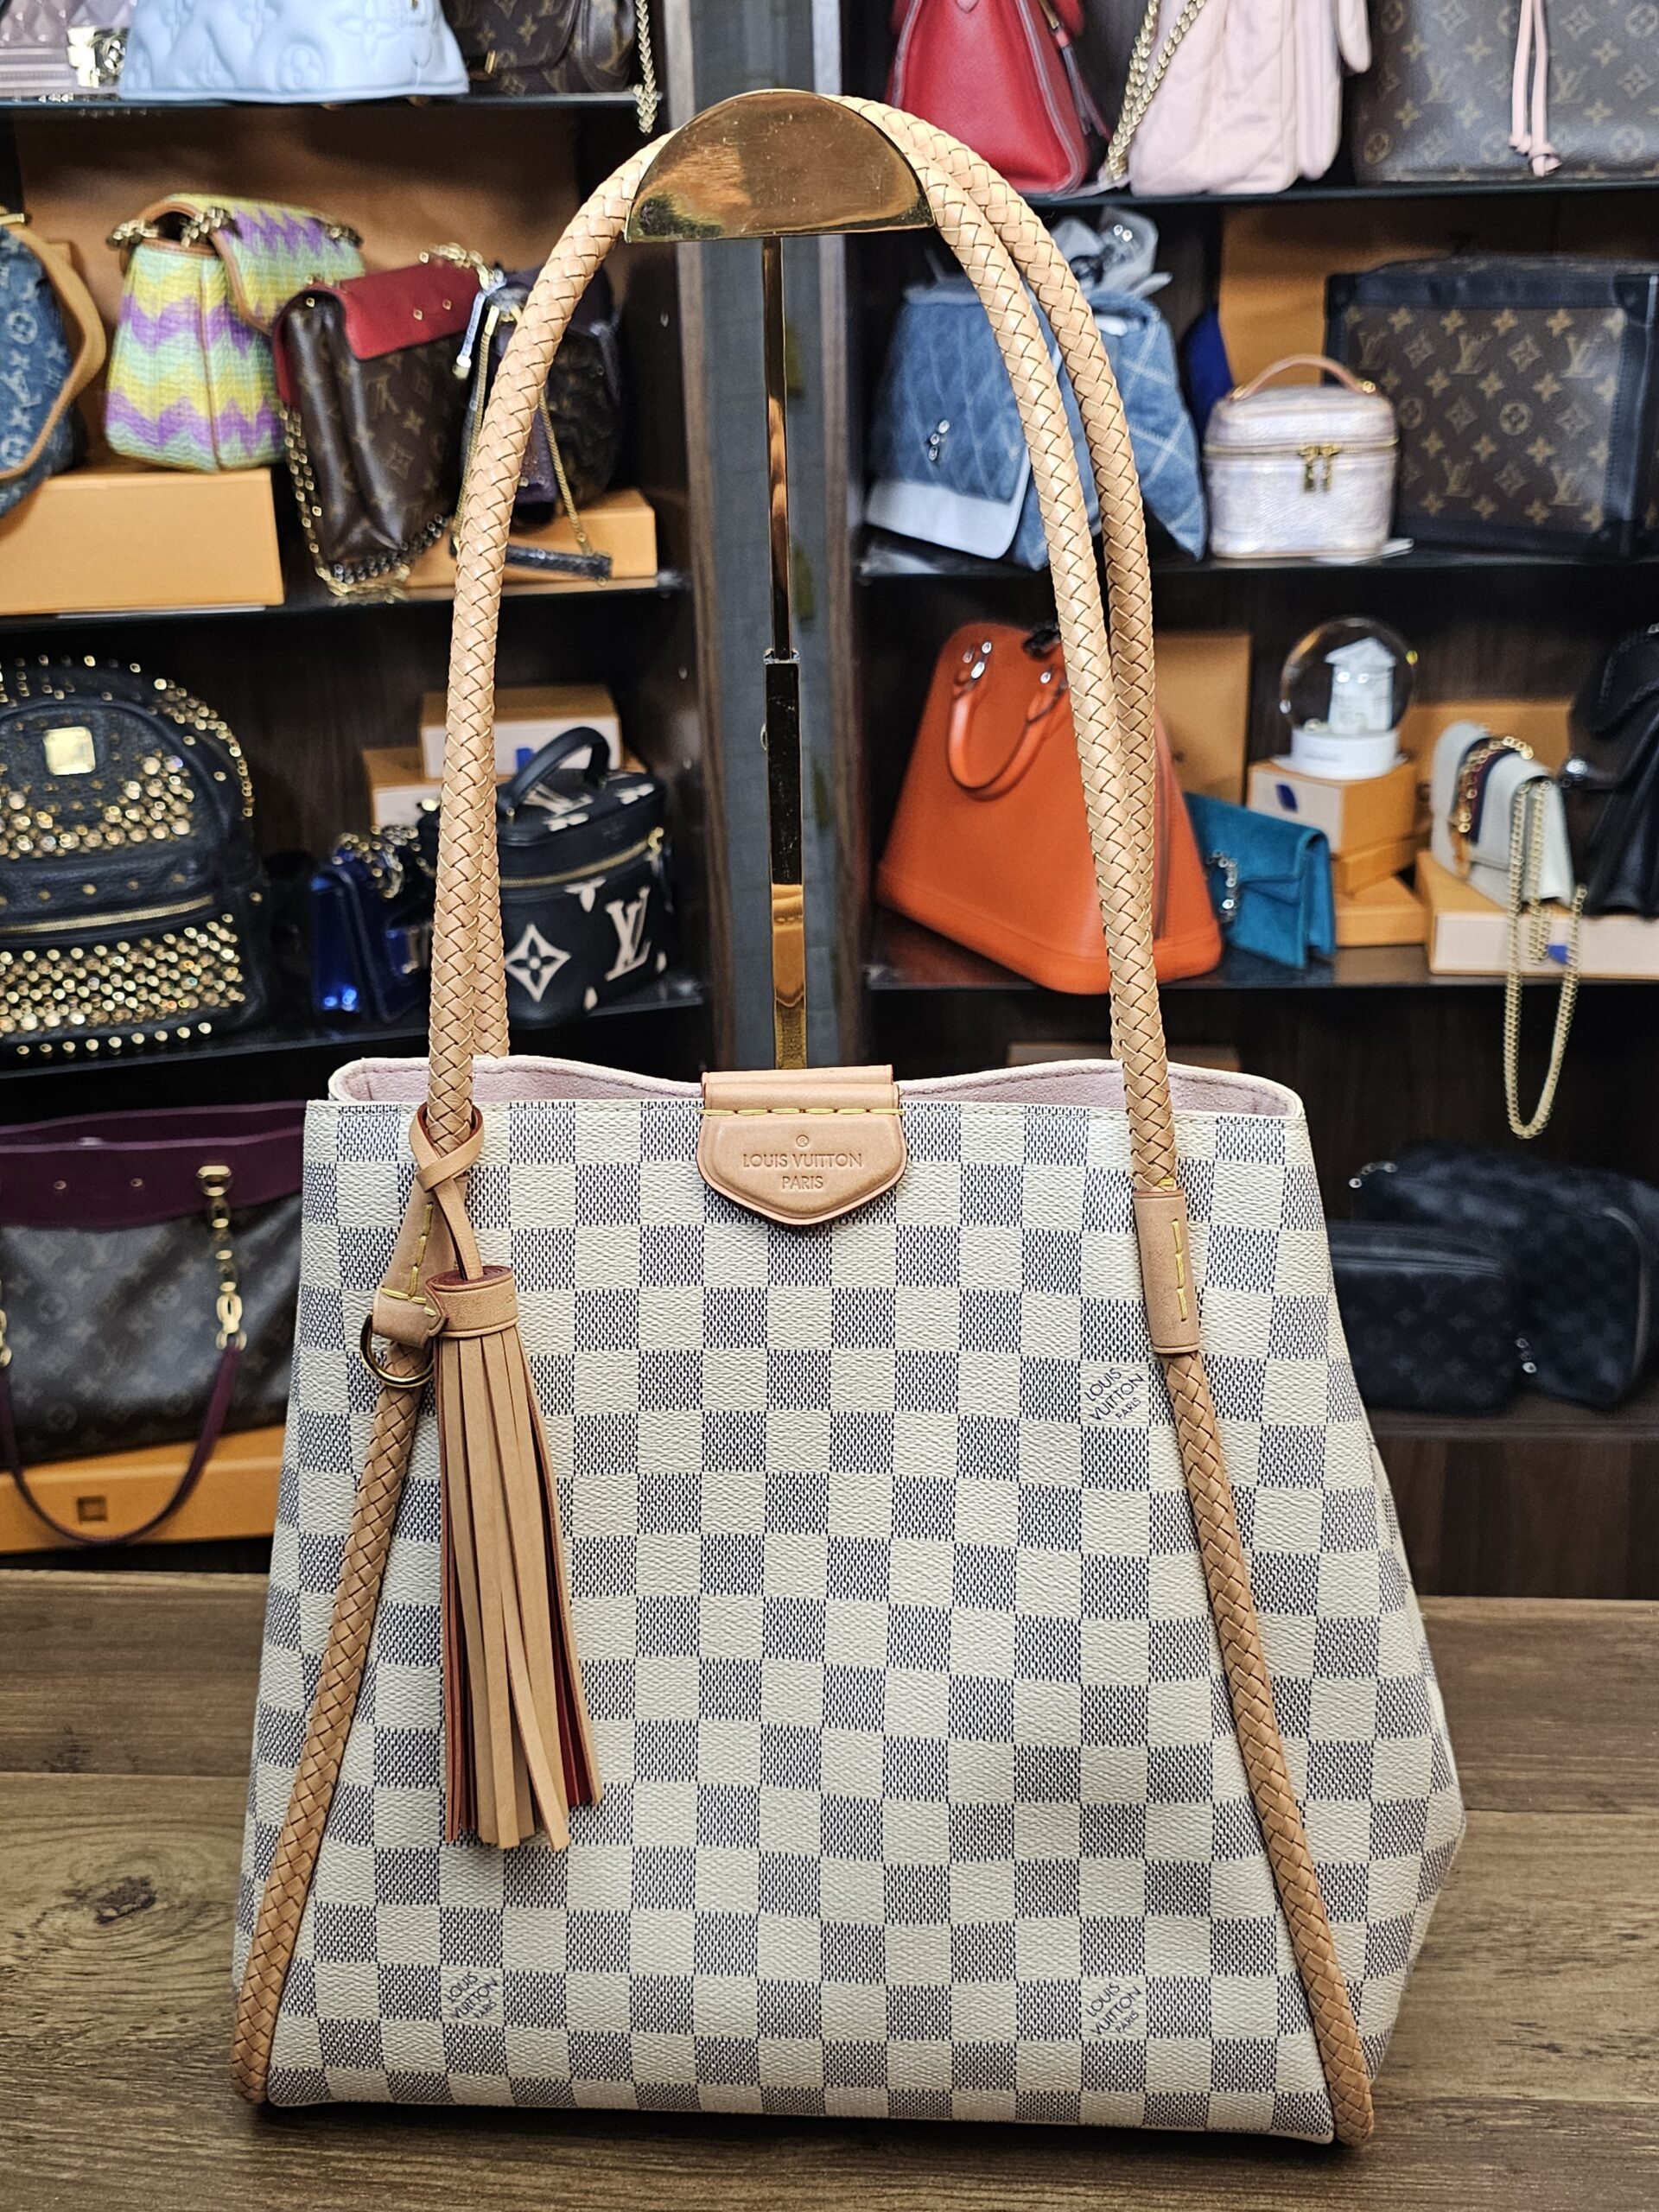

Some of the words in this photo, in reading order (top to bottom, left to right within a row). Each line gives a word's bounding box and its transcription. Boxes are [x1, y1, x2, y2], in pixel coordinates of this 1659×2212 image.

[605, 885, 653, 982] LV
[742, 1153, 788, 1168] LOUIS
[791, 1152, 863, 1168] VUITTON
[781, 1174, 823, 1190] PARIS
[1084, 1367, 1122, 1402] LOUIS
[1089, 1372, 1145, 1421] VUITTON
[1115, 1396, 1141, 1421] PARIS
[444, 1971, 479, 2004] LOUIS
[451, 1974, 499, 2018] VUITTON
[1084, 1981, 1121, 2018] LOUIS
[1090, 1985, 1142, 2036] VUITTON
[1115, 2009, 1140, 2034] PARIS
